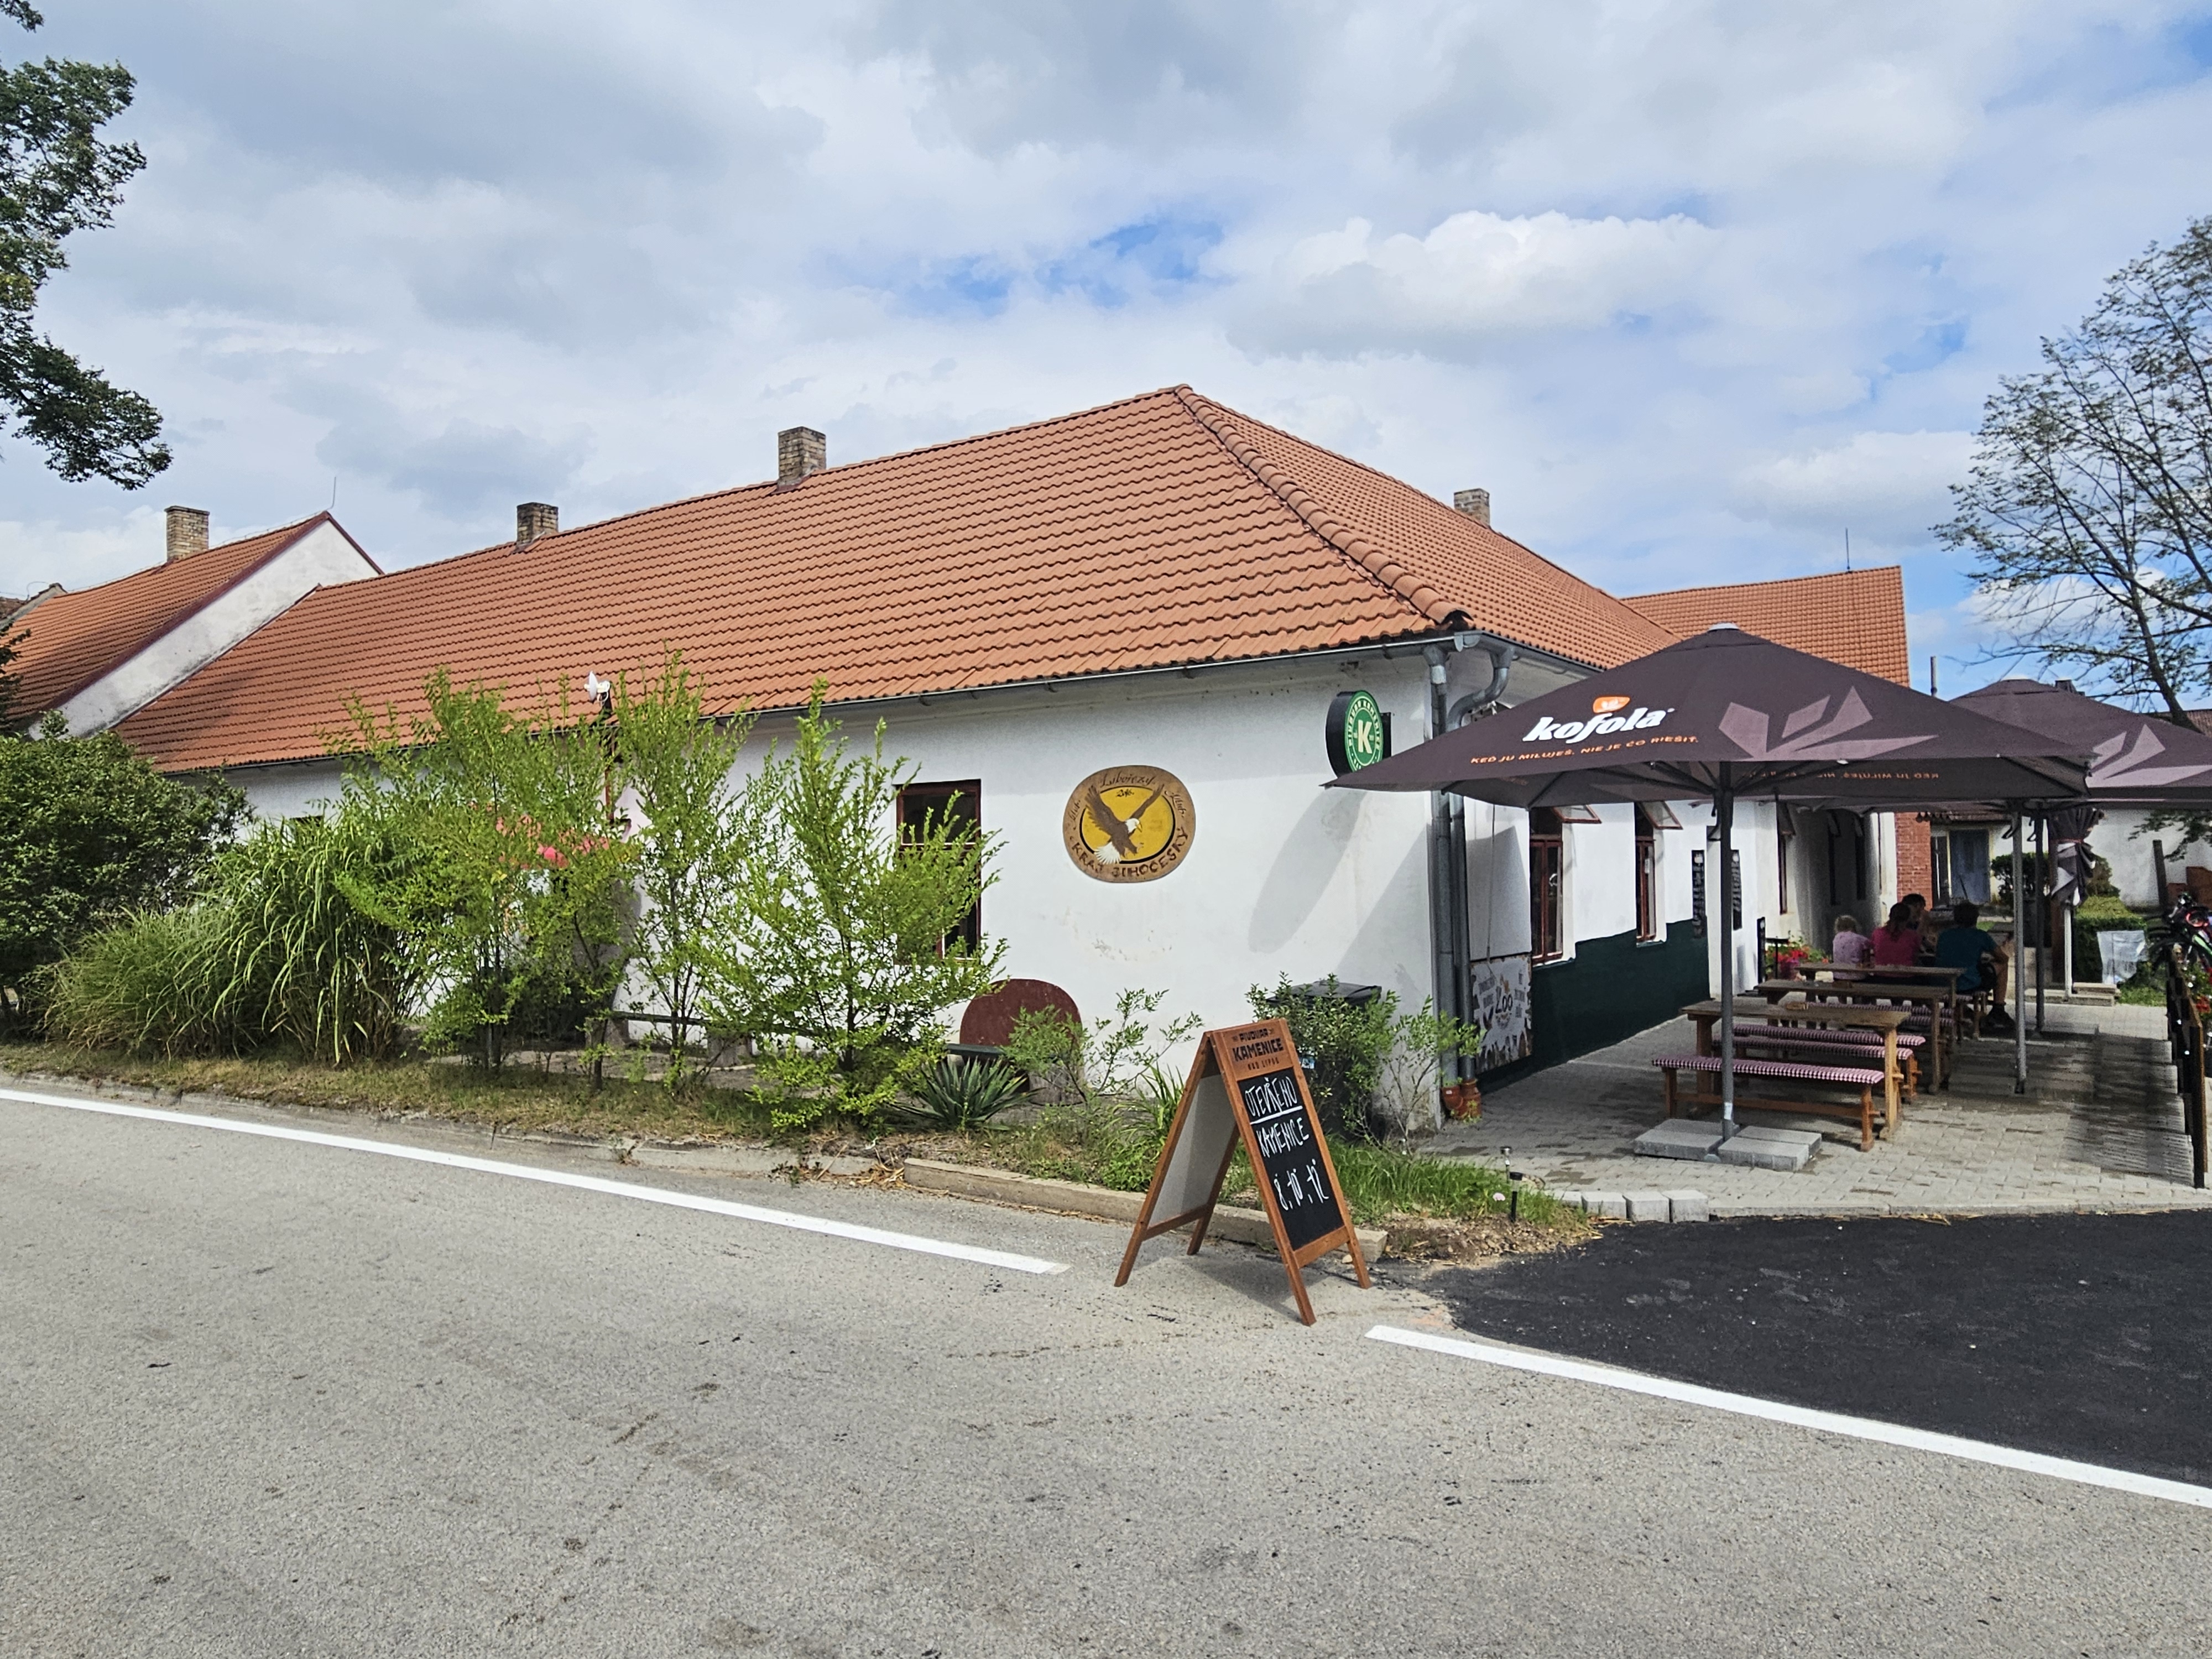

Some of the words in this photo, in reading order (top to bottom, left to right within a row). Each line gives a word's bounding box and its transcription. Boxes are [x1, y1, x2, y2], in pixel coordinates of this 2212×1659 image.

[1358, 719, 1373, 753] K
[1522, 707, 1666, 744] kofola
[1498, 755, 1515, 763] JU
[1580, 745, 1604, 754] NIE
[1605, 743, 1622, 752] JE
[1072, 842, 1103, 873] KRAJ
[1232, 1038, 1284, 1062] KAMENICE
[1239, 1028, 1269, 1042] PIVOVAR
[1256, 1117, 1310, 1158] KAMENICE
